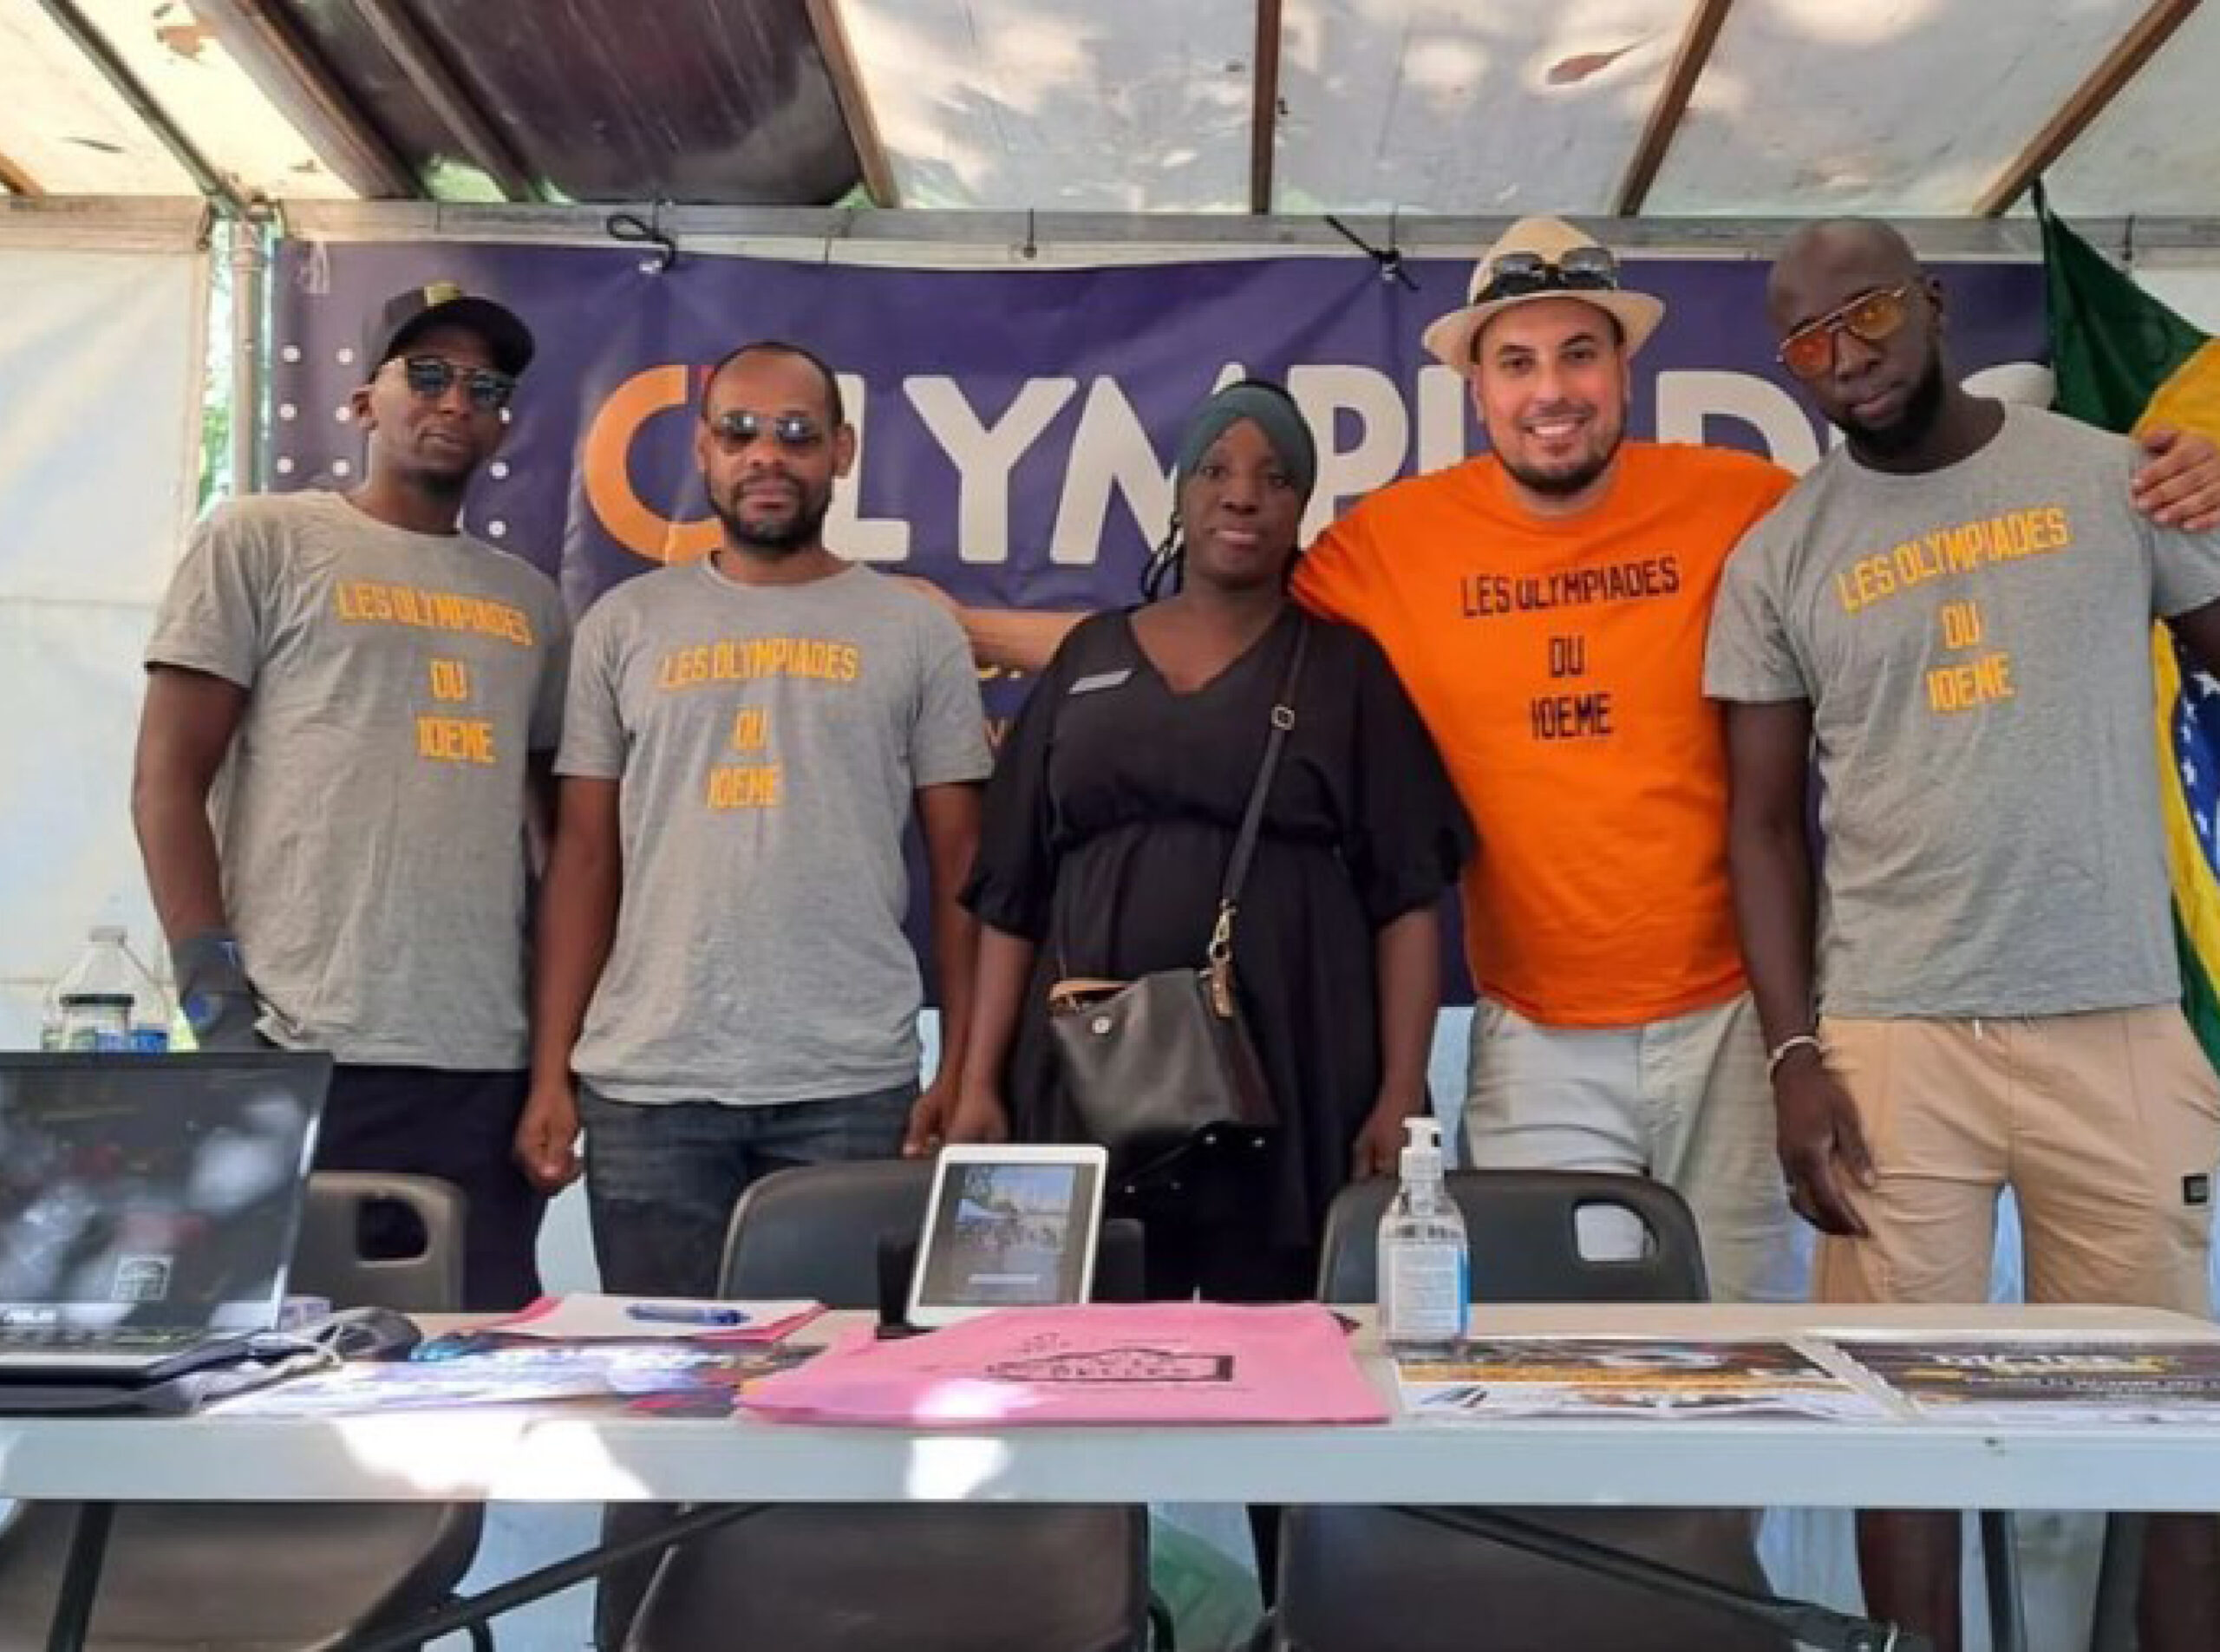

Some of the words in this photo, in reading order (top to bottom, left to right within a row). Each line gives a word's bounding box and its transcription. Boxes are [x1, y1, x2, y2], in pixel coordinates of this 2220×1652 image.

[1460, 574, 1510, 617] LES
[1515, 556, 1680, 611] OLYMPIADES
[1838, 555, 1894, 612] LES
[1893, 507, 2068, 587] OLYMPIADES
[1942, 601, 1980, 650] DU
[1549, 635, 1584, 678] DU
